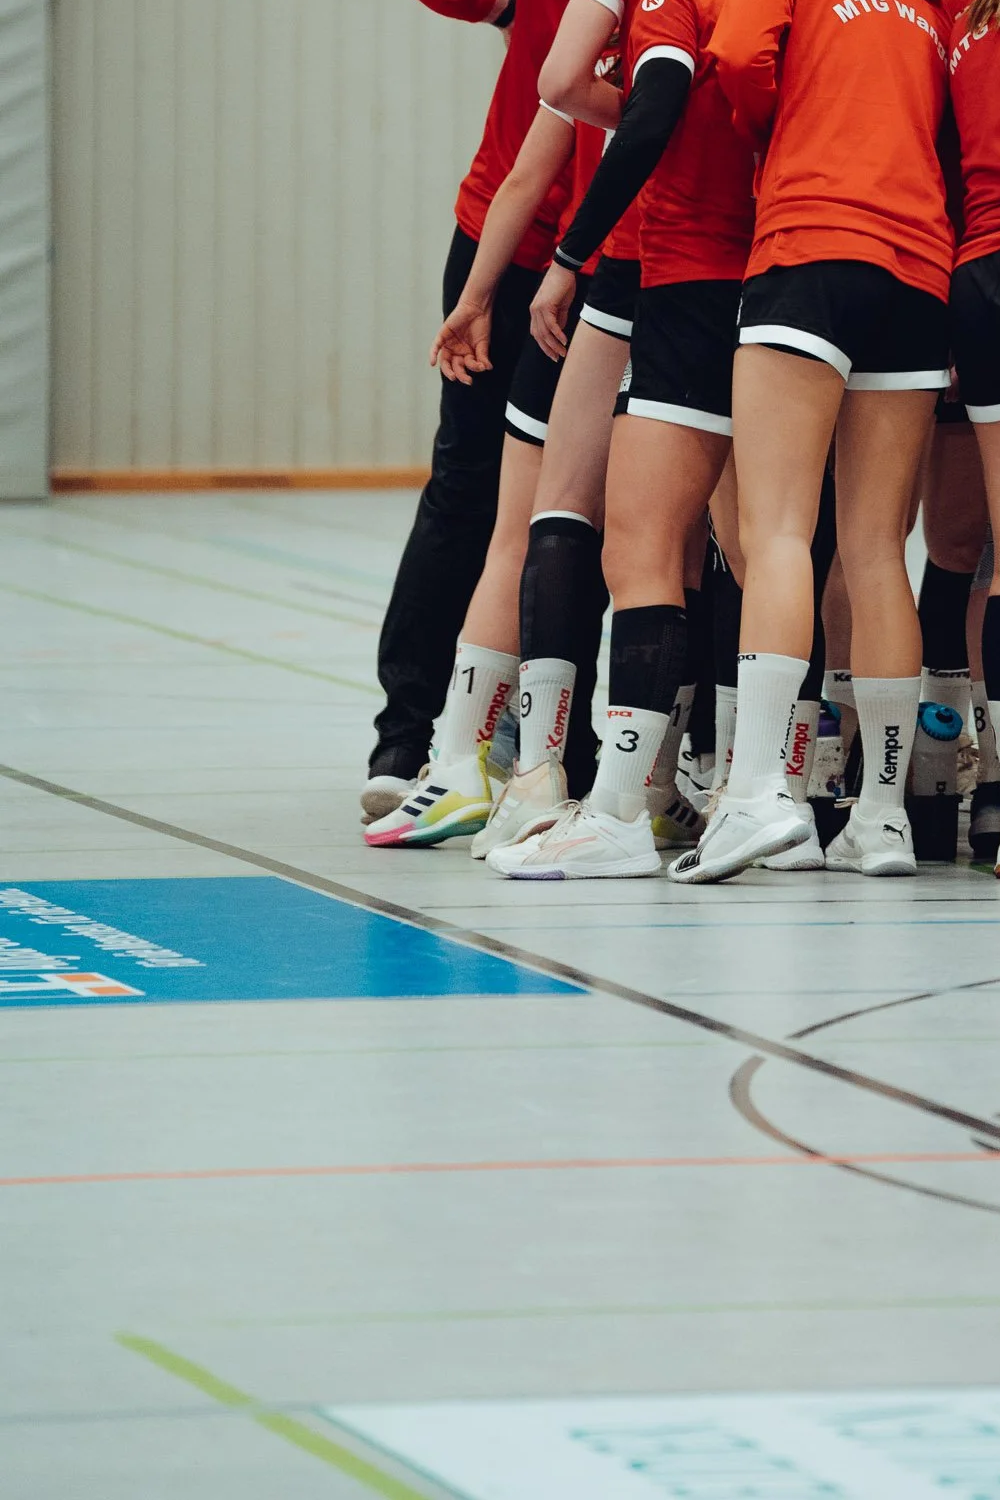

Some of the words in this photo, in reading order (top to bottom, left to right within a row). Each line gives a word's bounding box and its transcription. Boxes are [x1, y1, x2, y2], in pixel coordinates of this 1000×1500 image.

[476, 681, 512, 744] Kempa
[546, 688, 571, 750] Kempa
[615, 729, 640, 753] 3
[786, 722, 811, 777] Kempa
[878, 725, 903, 786] Kempa
